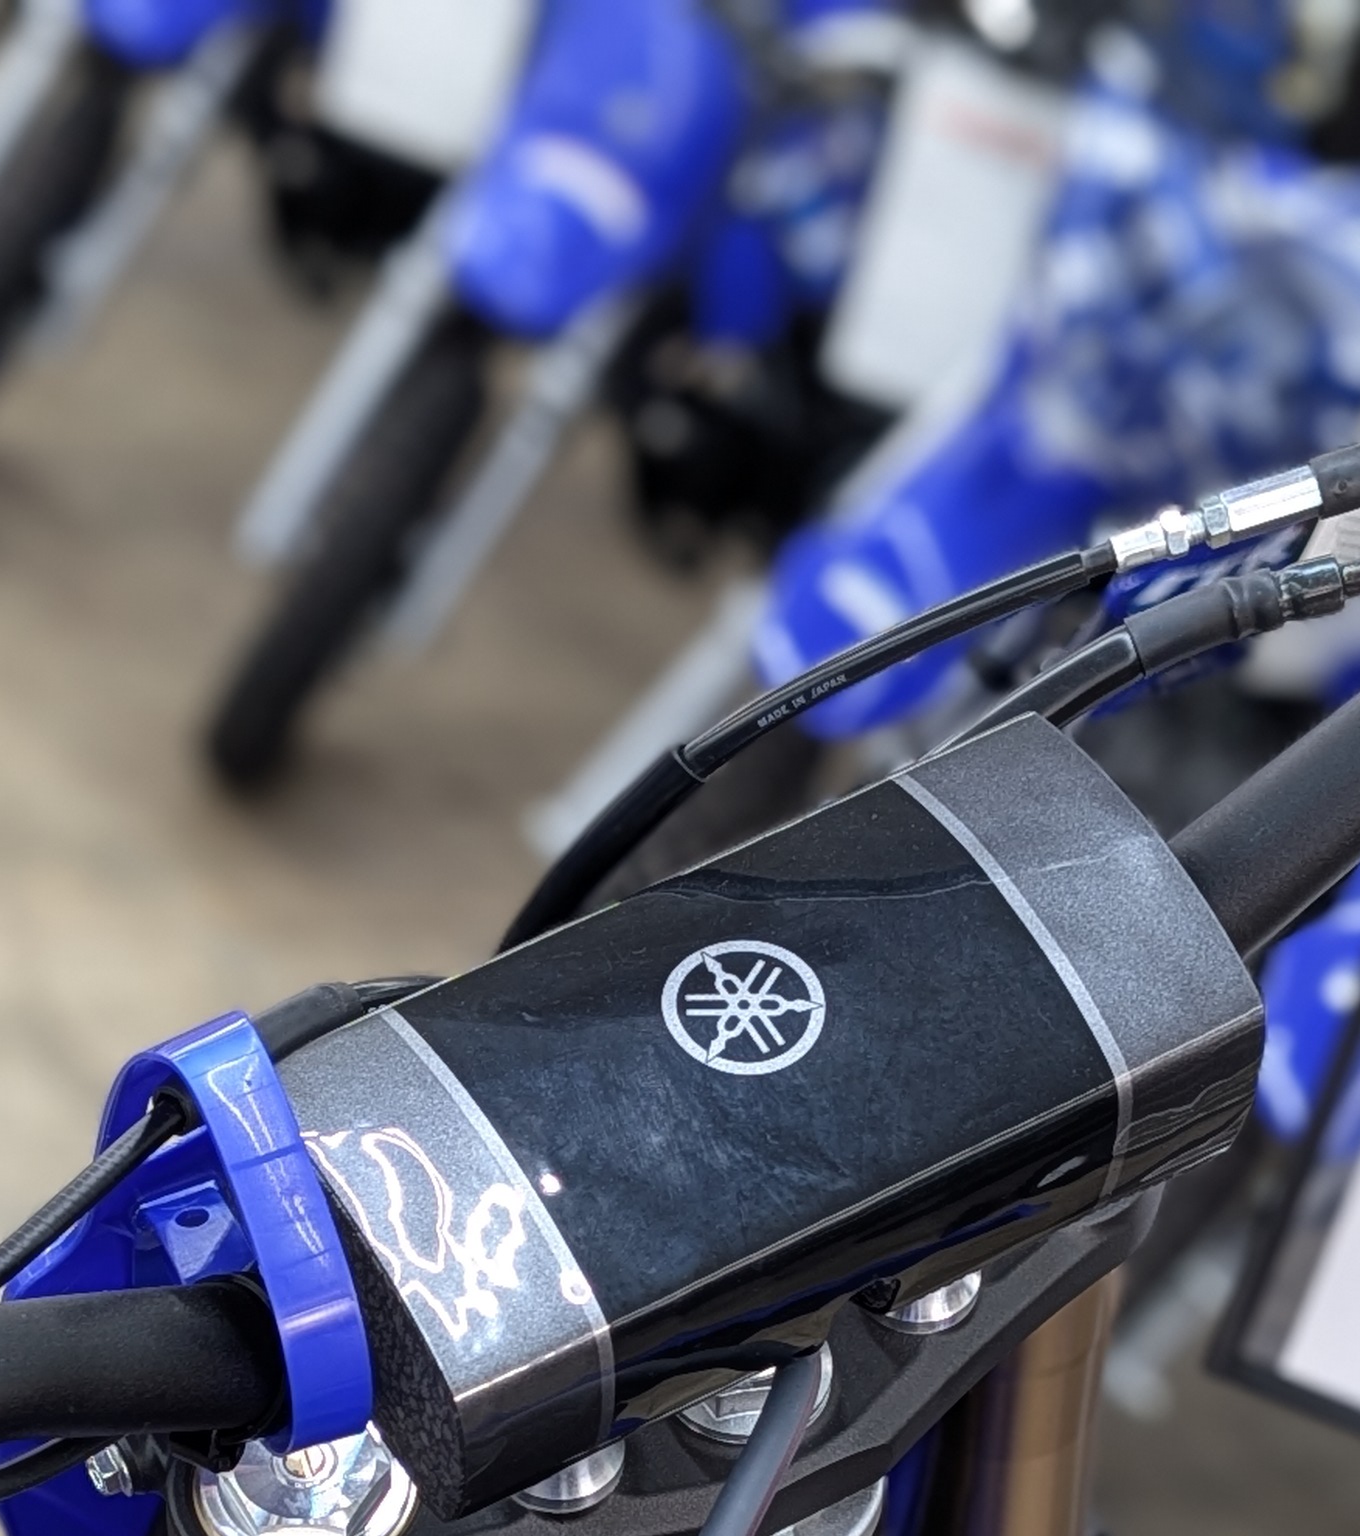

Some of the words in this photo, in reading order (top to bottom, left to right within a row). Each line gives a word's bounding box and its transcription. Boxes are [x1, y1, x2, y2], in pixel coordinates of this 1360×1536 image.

[757, 705, 789, 729] MADE
[792, 695, 806, 710] IN
[810, 673, 848, 700] JAPAN
